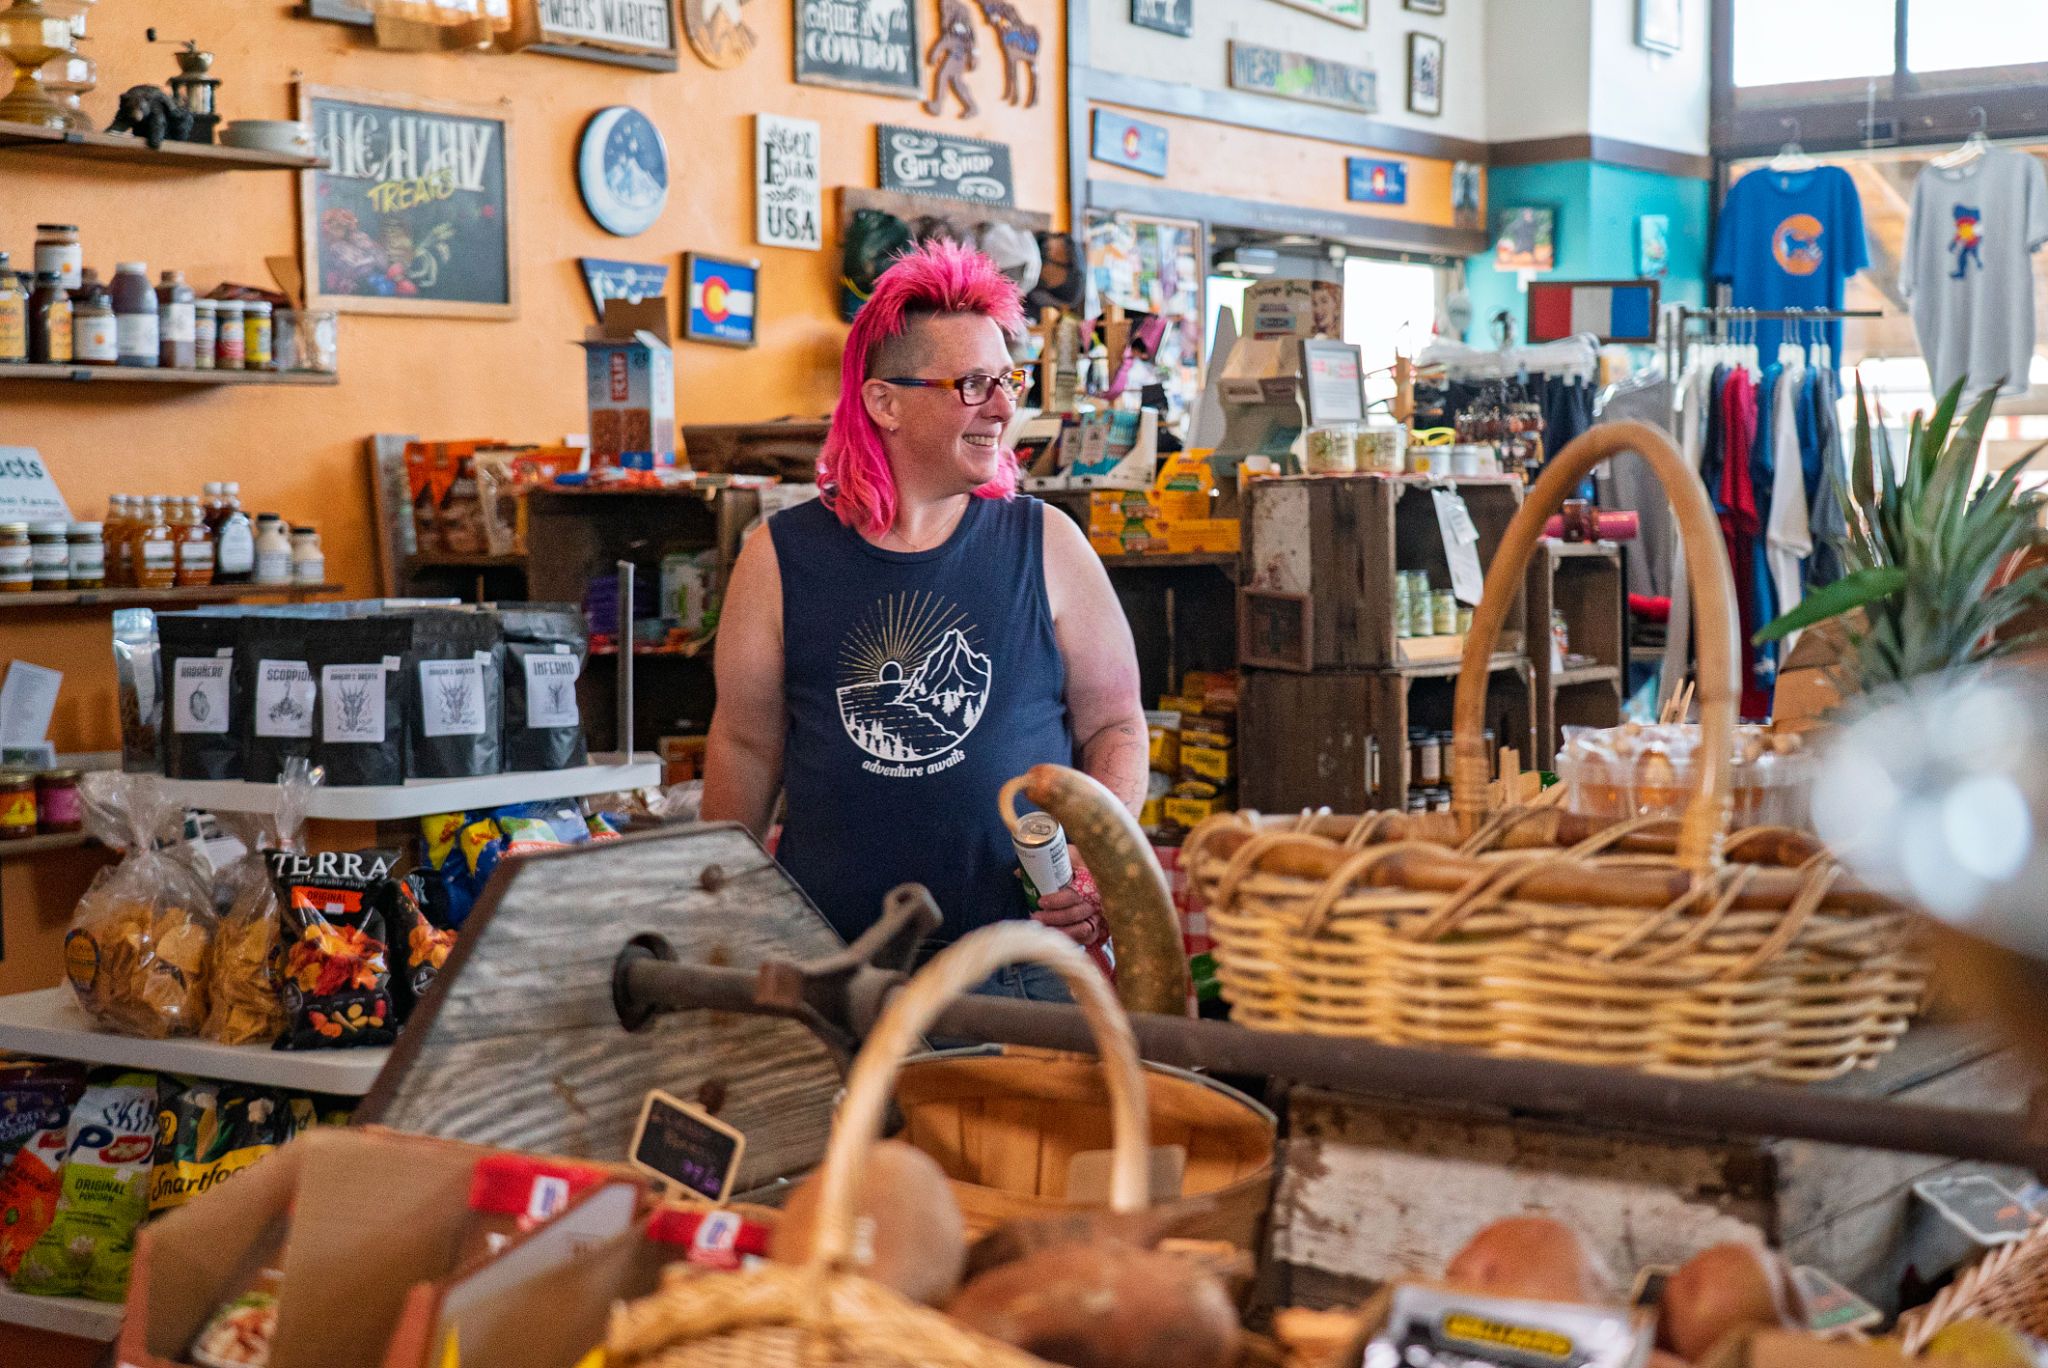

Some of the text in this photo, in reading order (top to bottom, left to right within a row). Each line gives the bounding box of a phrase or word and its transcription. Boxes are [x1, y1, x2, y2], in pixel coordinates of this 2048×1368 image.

[600, 0, 667, 41] MARKET
[806, 30, 910, 73] COWBOY
[767, 203, 816, 241] USA
[534, 660, 575, 676] INFERNO
[862, 748, 966, 777] adventure awaits
[272, 851, 388, 882] TERRA
[307, 891, 346, 903] ORIGINAL
[75, 1178, 126, 1195] ORIGINAL
